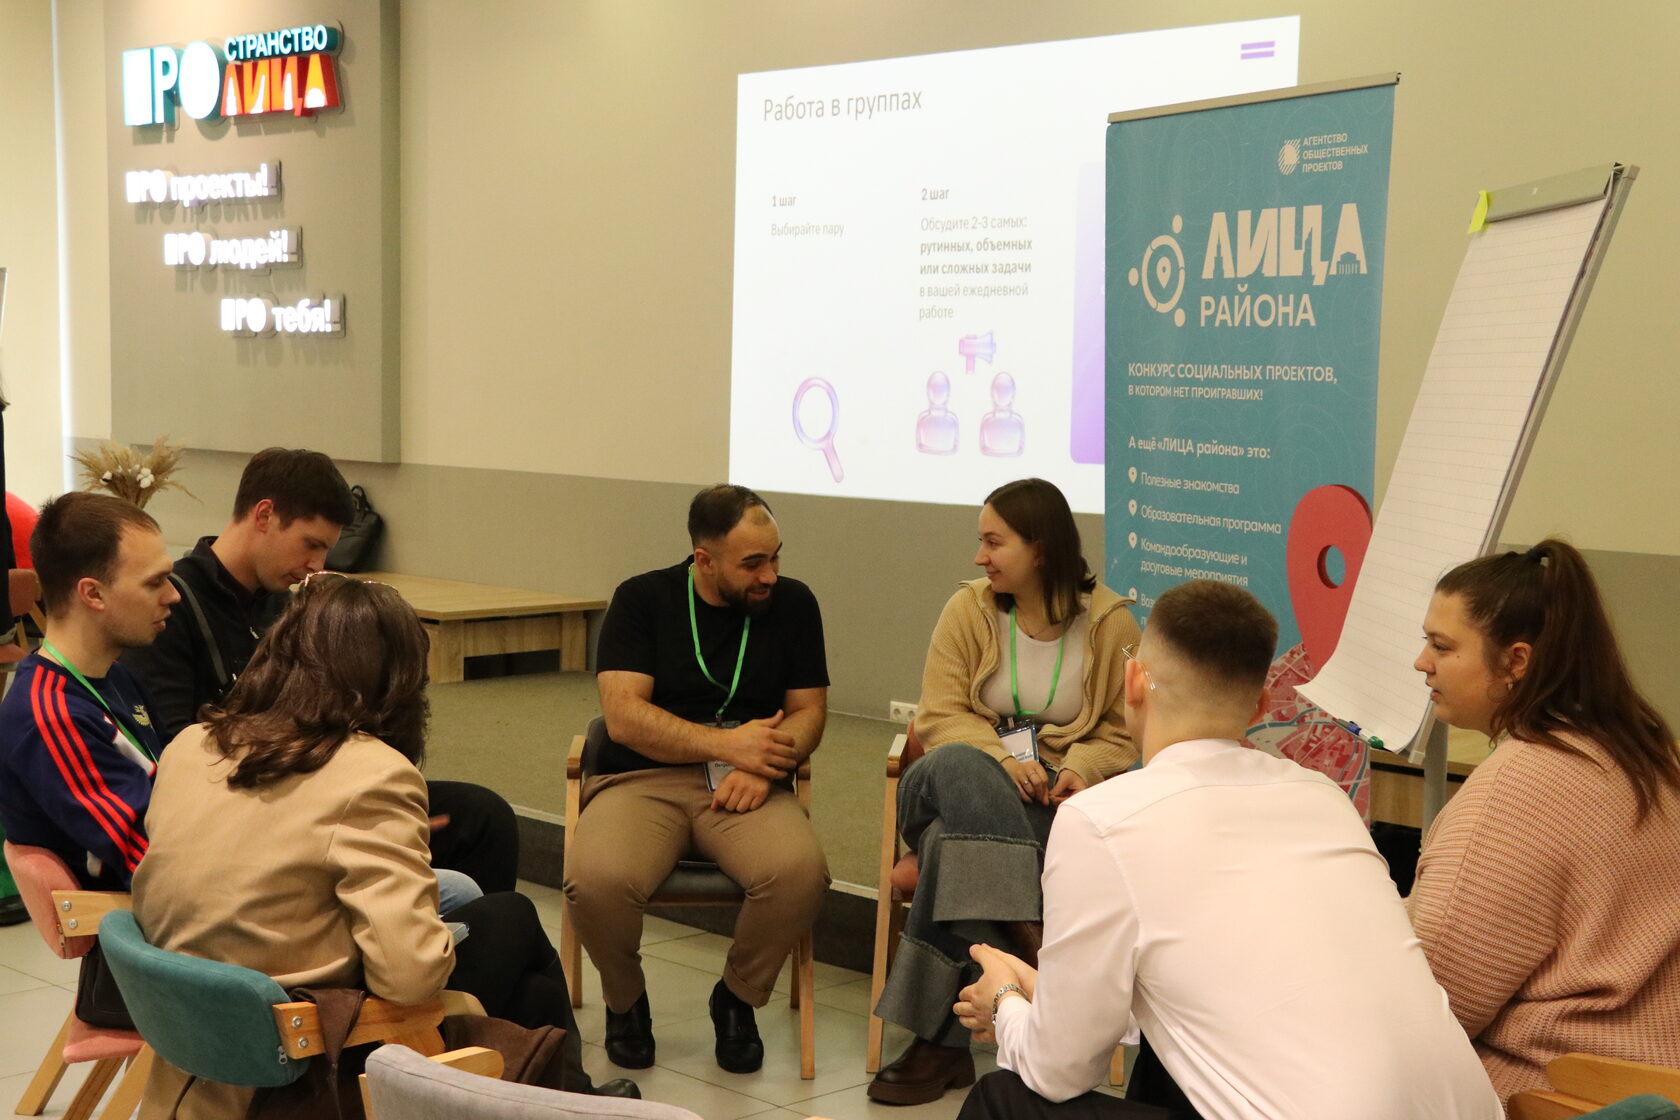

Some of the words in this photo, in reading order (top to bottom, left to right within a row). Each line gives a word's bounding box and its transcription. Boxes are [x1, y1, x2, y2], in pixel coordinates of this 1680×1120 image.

[224, 24, 328, 62] СТРАНСТВО
[122, 41, 221, 126] ПРО
[220, 53, 328, 117] ЛИЦА
[763, 95, 825, 122] Работа
[831, 99, 841, 117] в
[847, 91, 922, 121] группах
[1303, 133, 1348, 146] АГЕНТСТВО
[1302, 144, 1369, 160] ОБЩЕСТВЕННЫХ
[1302, 160, 1343, 173] ПРОЕКТОВ
[125, 170, 167, 203] ПРО
[170, 163, 268, 207] проекты!
[921, 188, 928, 201] 2
[929, 189, 950, 200] шаг
[772, 195, 777, 207] 1
[779, 196, 797, 207] шаг
[771, 222, 821, 238] Выбирайте
[822, 224, 845, 238] пару
[920, 216, 970, 233] Обсудите
[971, 216, 989, 230] 2-3
[163, 232, 206, 266] ПРО
[209, 229, 289, 269] людей!
[920, 241, 974, 256] рутинных,
[976, 238, 1033, 252] объемных
[1201, 203, 1368, 286] ЛИЦА
[920, 264, 939, 275] или
[941, 264, 990, 274] сложных
[991, 262, 1032, 276] задачи
[919, 286, 926, 297] в
[927, 283, 961, 297] вашей
[962, 283, 1029, 299] ежедневной
[221, 298, 266, 332] ПРО
[272, 299, 331, 333] тебя!
[919, 305, 954, 321] работе
[1200, 284, 1316, 328] РАЙОНА
[1128, 363, 1175, 378] КОНКУРС
[1177, 364, 1263, 381] СОЦИАЛЬНЫХ
[1266, 366, 1338, 384] ПРОЕКТОВ,
[1128, 385, 1134, 395] В
[1135, 386, 1172, 397] КОТОРОМ
[1173, 387, 1190, 398] НЕТ
[1191, 387, 1264, 400] ПРОИГРАВШИХ!
[1128, 436, 1136, 448] А
[1138, 438, 1157, 451] ещё
[1158, 438, 1194, 455] «ЛИЦА
[1197, 440, 1245, 457] района»
[1247, 447, 1271, 459] это:
[1141, 472, 1182, 489] Полезные
[1183, 479, 1240, 494] знакомства
[1141, 505, 1221, 527] Образовательная
[1222, 517, 1282, 534] программа
[1141, 539, 1240, 565] Командообразующие
[1241, 555, 1248, 565] и
[1141, 561, 1183, 577] досуговые
[1184, 567, 1249, 587] мероприятия
